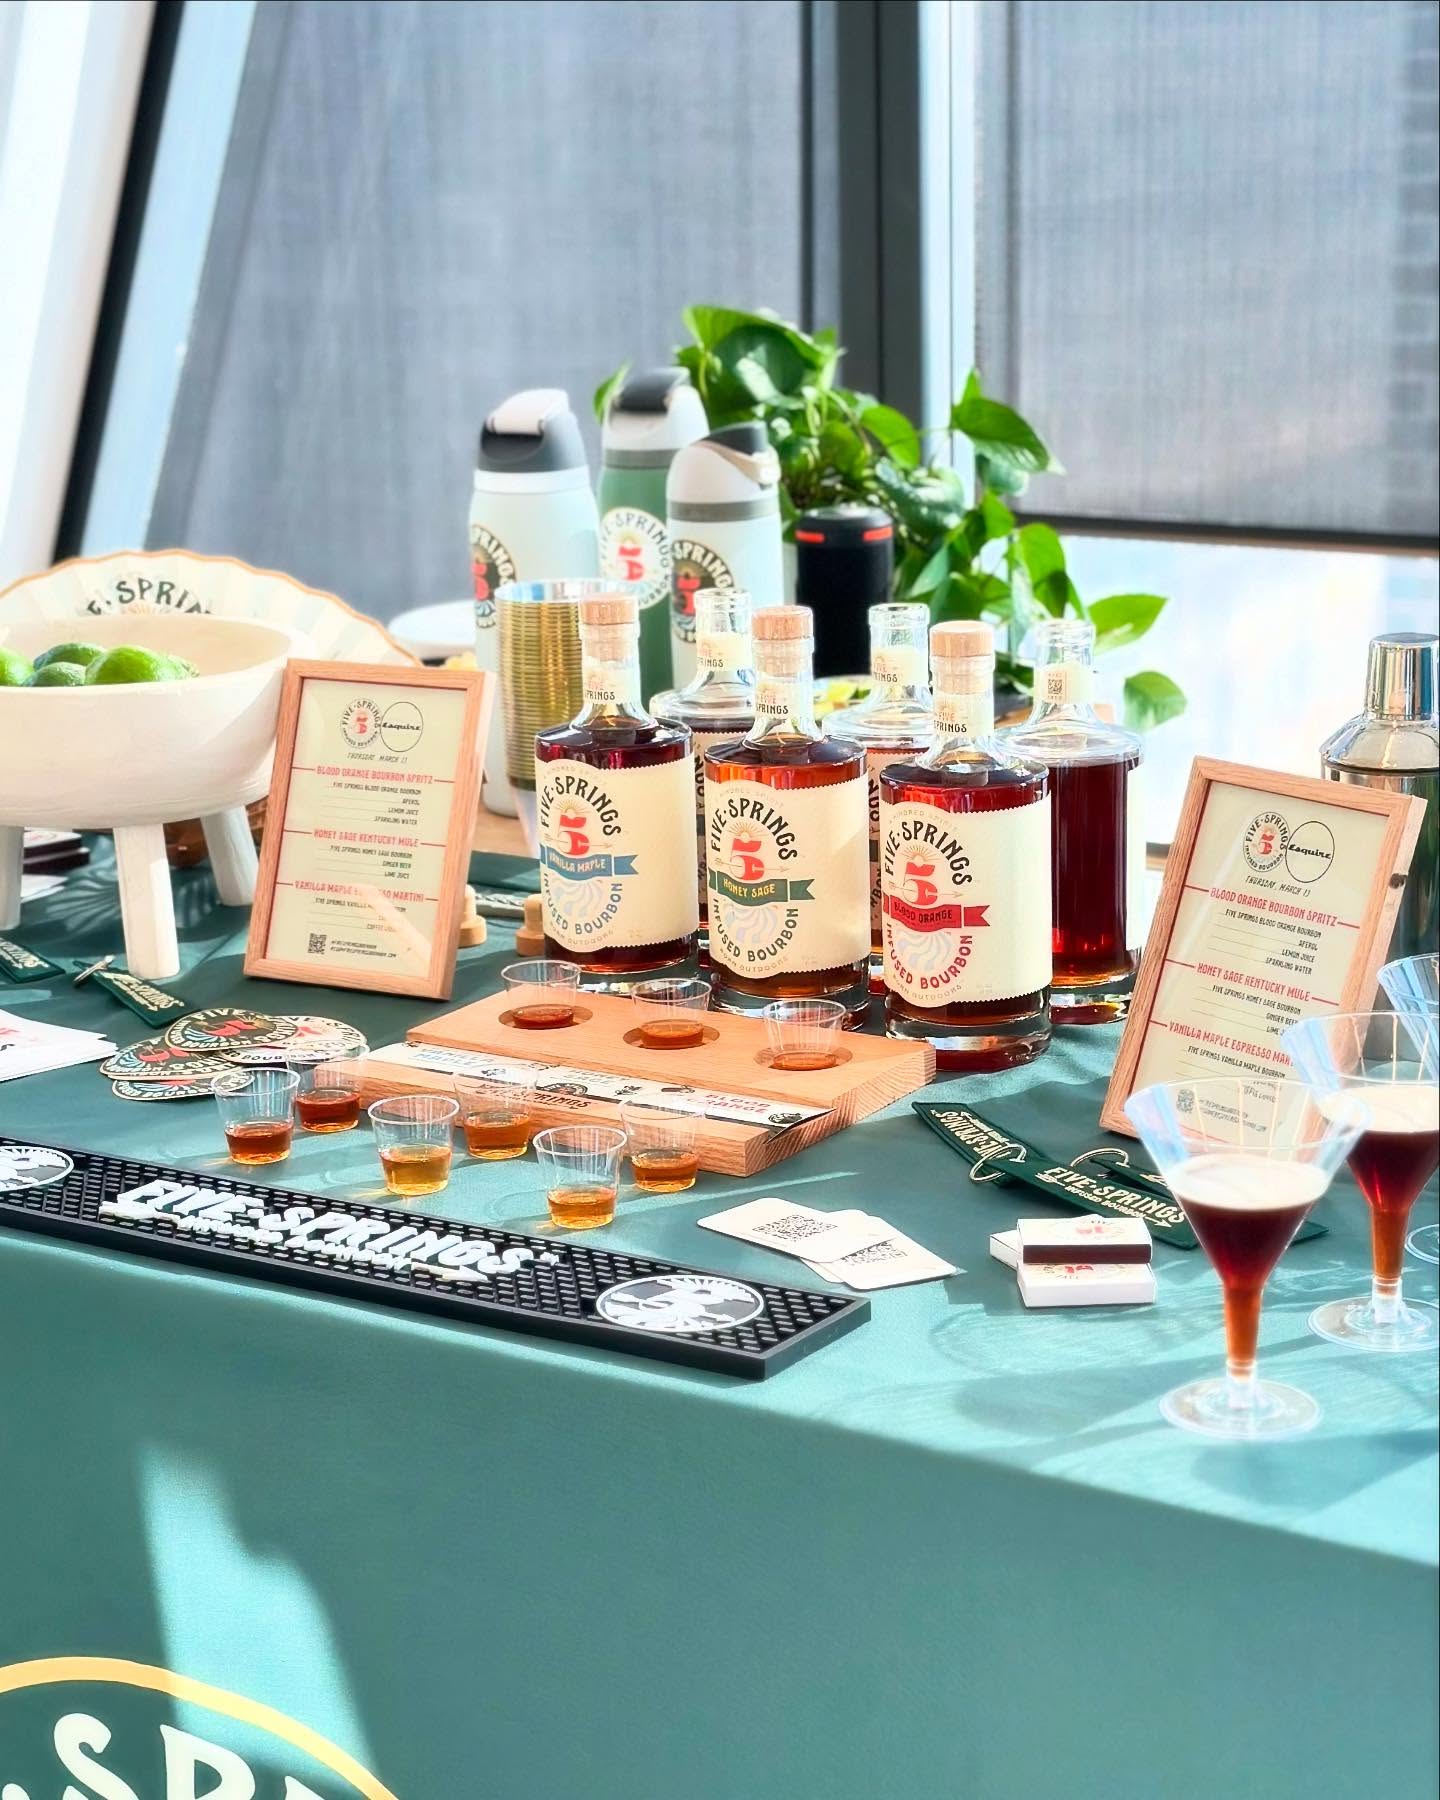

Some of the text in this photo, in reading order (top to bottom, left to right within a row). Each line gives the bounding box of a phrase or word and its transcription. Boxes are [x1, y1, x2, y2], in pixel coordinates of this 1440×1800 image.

[316, 765, 340, 776] BLOOD
[540, 775, 622, 837] FIVE SPRINGS
[313, 829, 336, 839] HONEY
[712, 808, 727, 852] FIVE
[728, 798, 798, 861] SPRINGS
[577, 858, 606, 873] MAPLE
[885, 820, 973, 886] FIVE SPRINGS
[1288, 844, 1332, 860] Esquire
[542, 873, 623, 936] INFUSED BOURBON
[724, 879, 776, 898] HONEY SAGE
[1209, 887, 1338, 927] BLOOD ORANGE BOURBON SPRITZ
[712, 899, 799, 962] INFUSED BOURBON
[918, 909, 952, 924] ORANGE
[1224, 908, 1236, 917] FIVE
[1258, 916, 1276, 927] BLOOD
[886, 923, 973, 990] INFUSED BOURBON
[1196, 962, 1311, 1002] HONEY SAGE KENTUCKY MULE
[191, 1008, 245, 1021] FIVE
[1168, 1020, 1202, 1040] VANILLA
[1201, 1030, 1230, 1048] MAPLE
[1230, 1038, 1271, 1060] ESPRESSO
[1044, 1166, 1186, 1223] FIVE SPRINGS
[1064, 1186, 1146, 1218] INFUSED BOURBON
[116, 1179, 534, 1276] FIVE SPRINGS
[54, 1712, 327, 1800] SP
